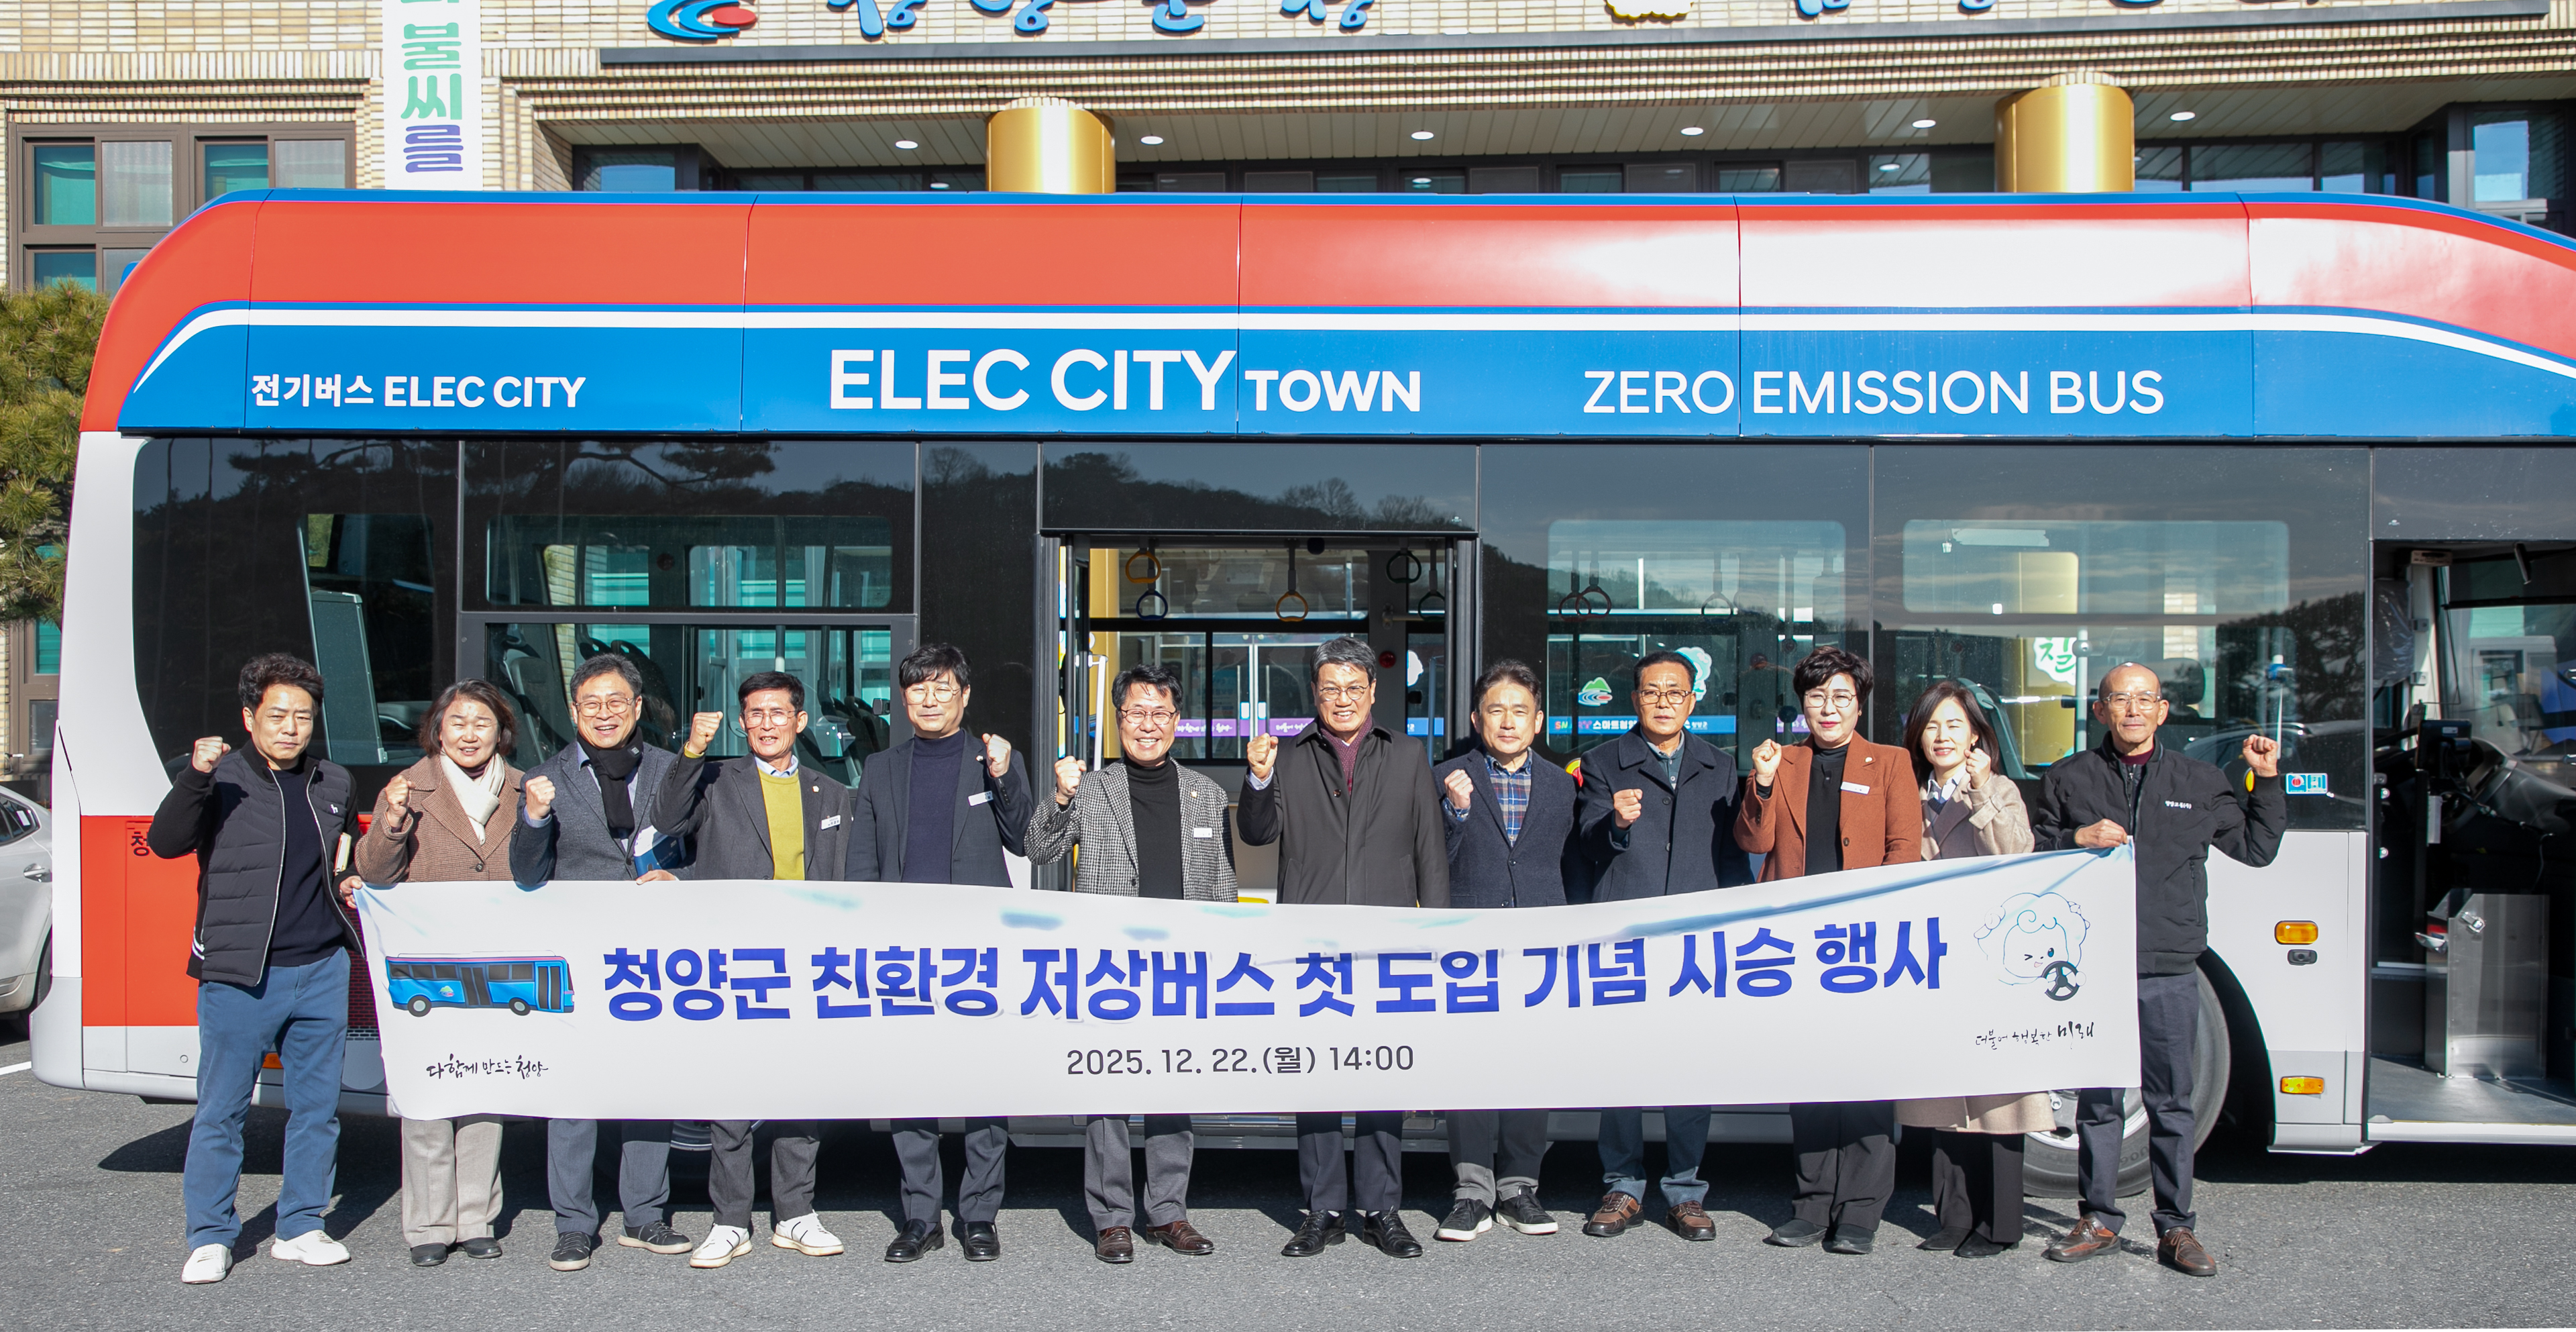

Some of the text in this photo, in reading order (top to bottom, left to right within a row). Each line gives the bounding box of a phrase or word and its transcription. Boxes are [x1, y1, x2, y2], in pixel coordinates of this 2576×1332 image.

[400, 22, 464, 173] 불씨를
[252, 374, 587, 408] 전기버스 ELEC CITY
[830, 348, 1421, 413] ELEC CITY TOWN
[1583, 370, 2165, 415] ZERO EMISSION BUS
[603, 917, 1948, 1021] 청양군 친환경 저상버스 첫 도입 기념 시승 행사
[1975, 1020, 2095, 1050] 더불어 행복한 미래
[426, 1053, 549, 1080] 다함께 만드는 청양
[1067, 1049, 1152, 1075] 2025.
[1161, 1049, 1203, 1074] 12.
[1330, 1045, 1415, 1071] 14:00
